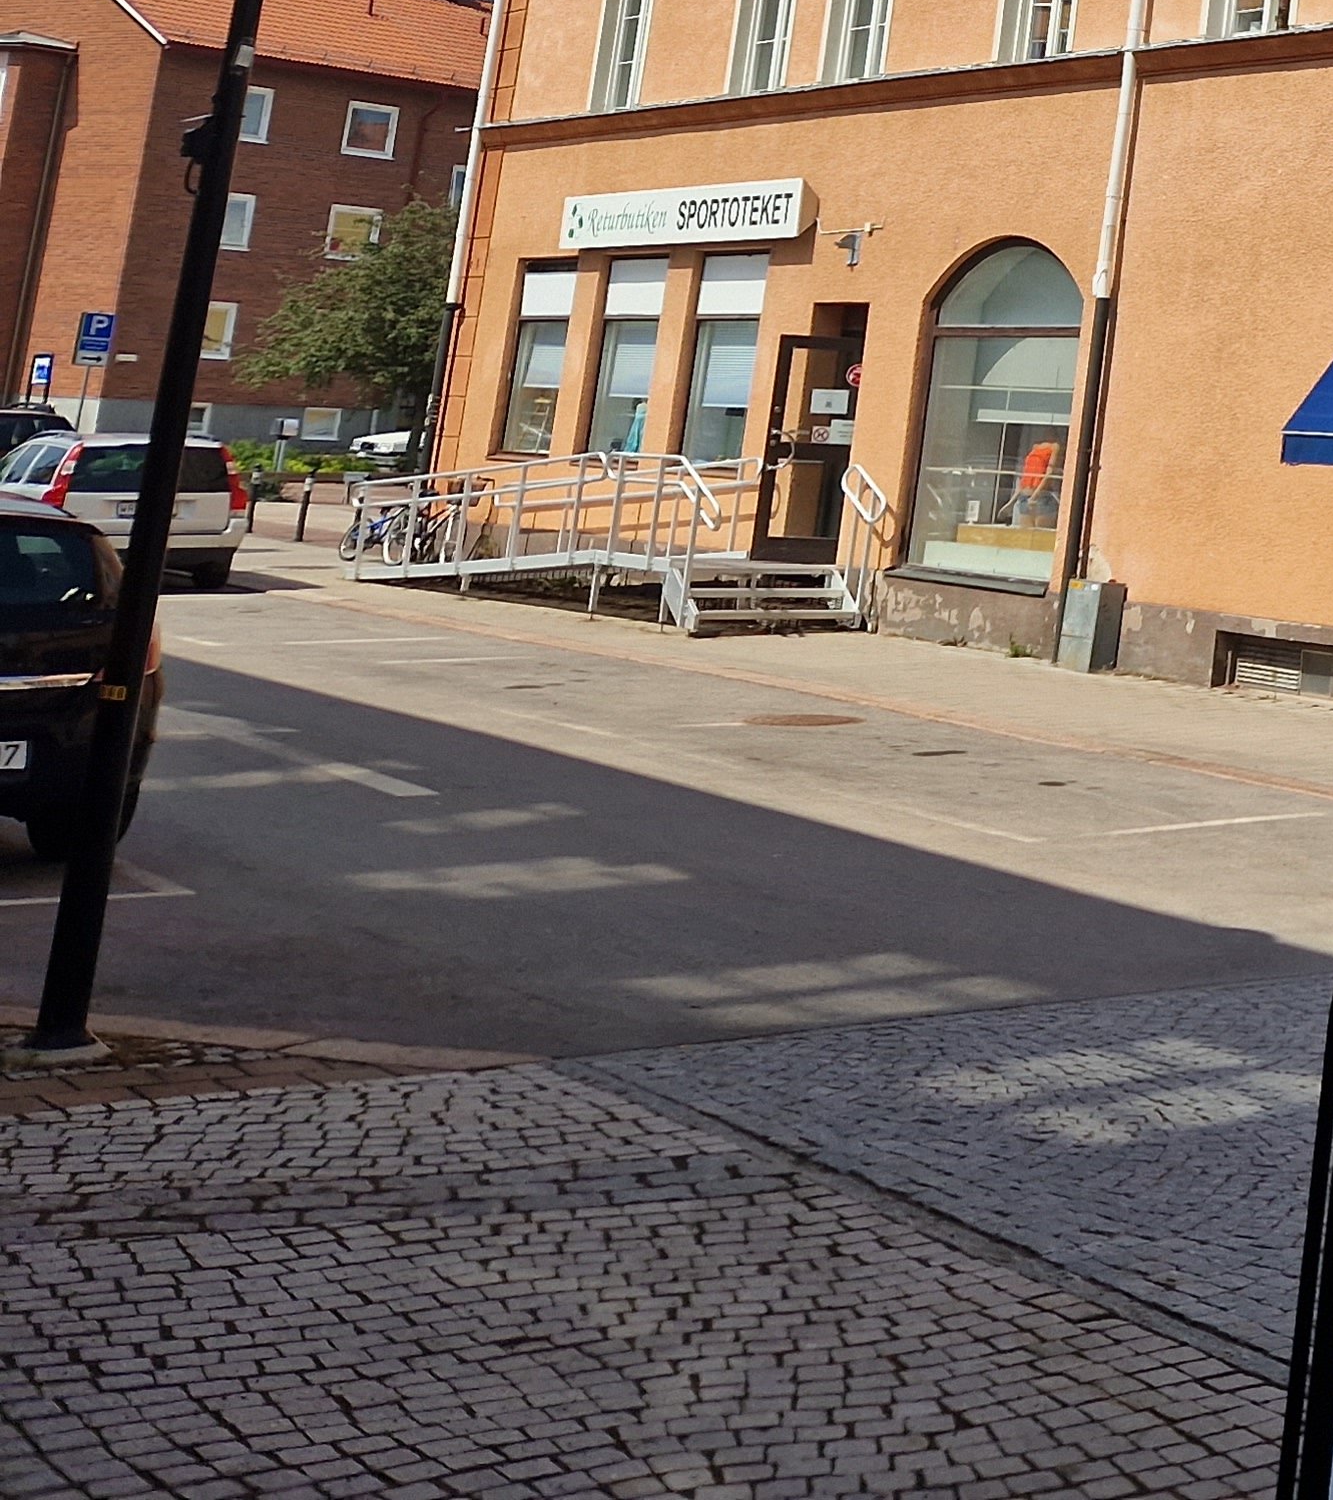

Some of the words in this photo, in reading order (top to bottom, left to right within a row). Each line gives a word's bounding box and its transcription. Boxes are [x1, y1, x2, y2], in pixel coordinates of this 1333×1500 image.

[587, 200, 667, 237] Returbutiken
[676, 193, 793, 231] SPORTOTEKET
[89, 315, 109, 336] P
[0, 744, 20, 766] 7
